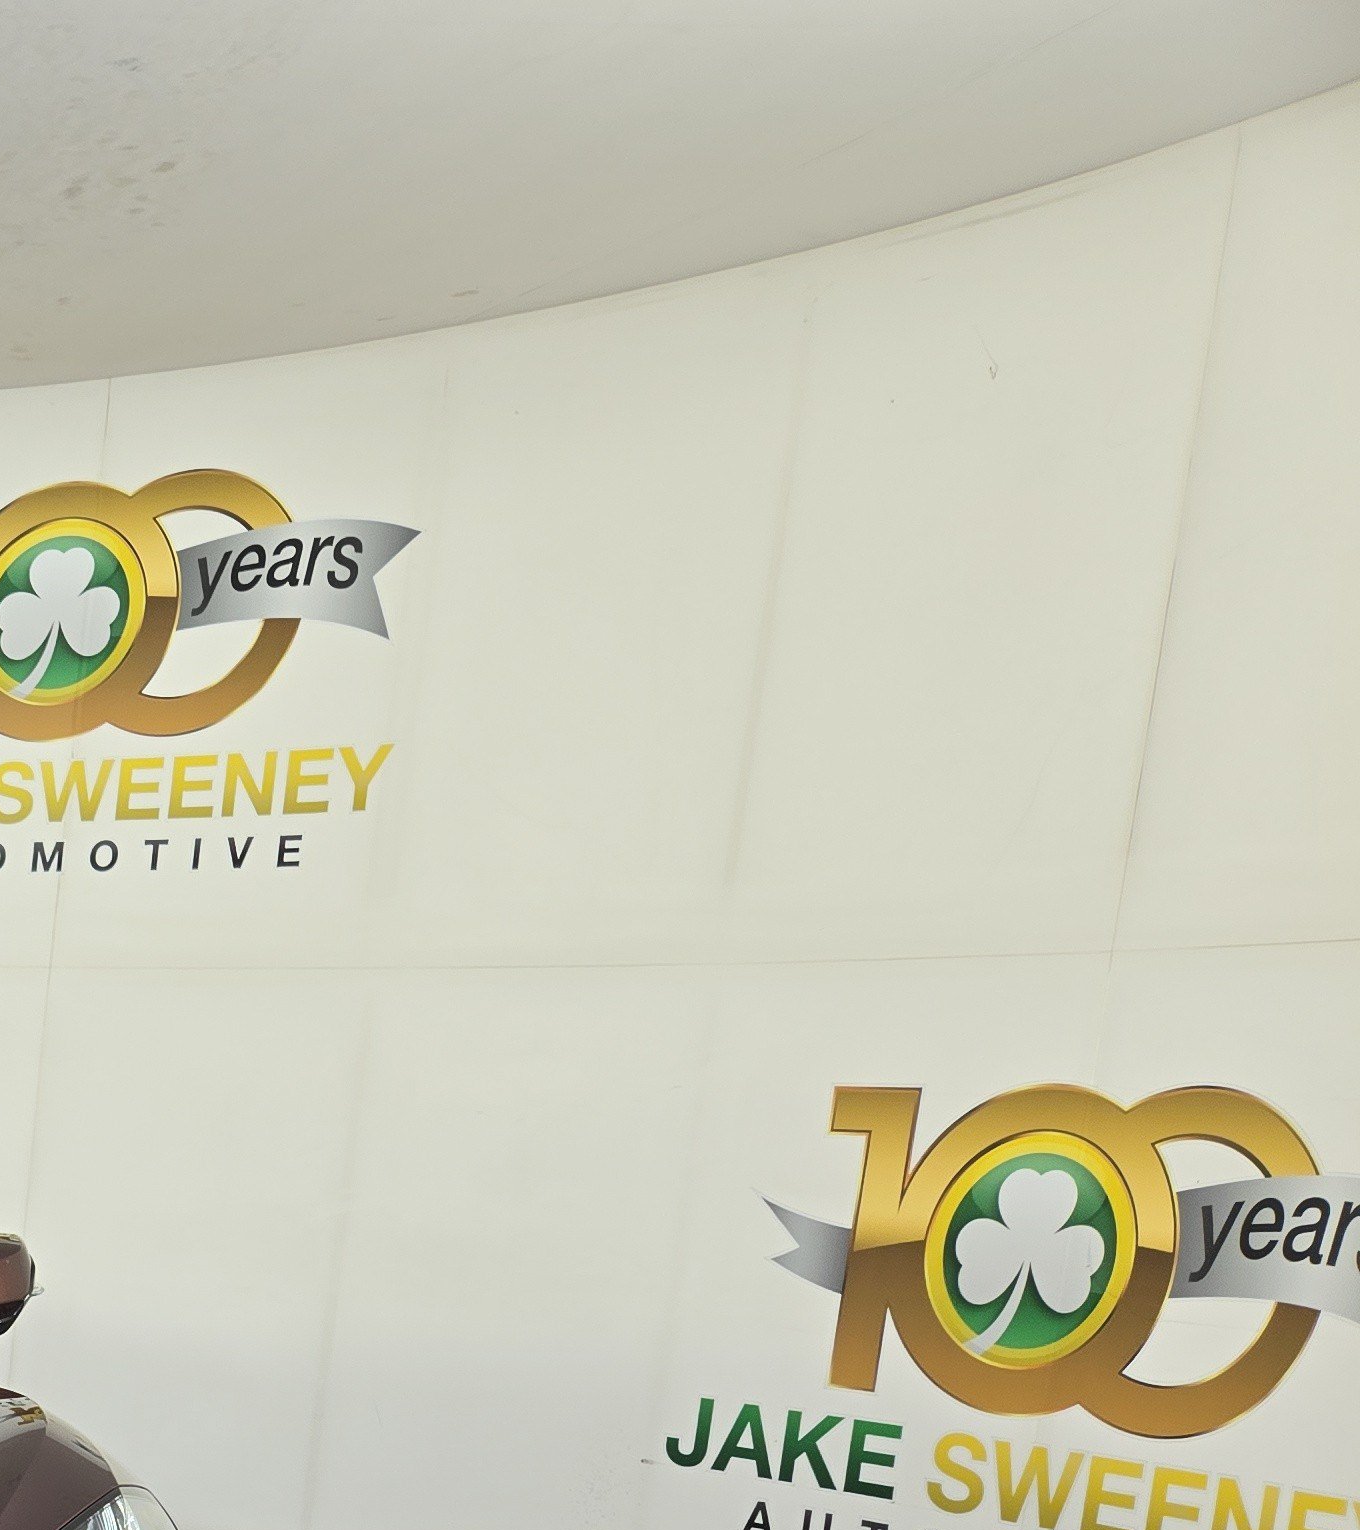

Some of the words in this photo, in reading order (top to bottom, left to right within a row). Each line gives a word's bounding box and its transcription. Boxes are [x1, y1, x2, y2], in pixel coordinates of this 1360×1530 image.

[190, 535, 363, 616] years
[1188, 1197, 1360, 1282] year
[665, 1397, 903, 1500] JAKE
